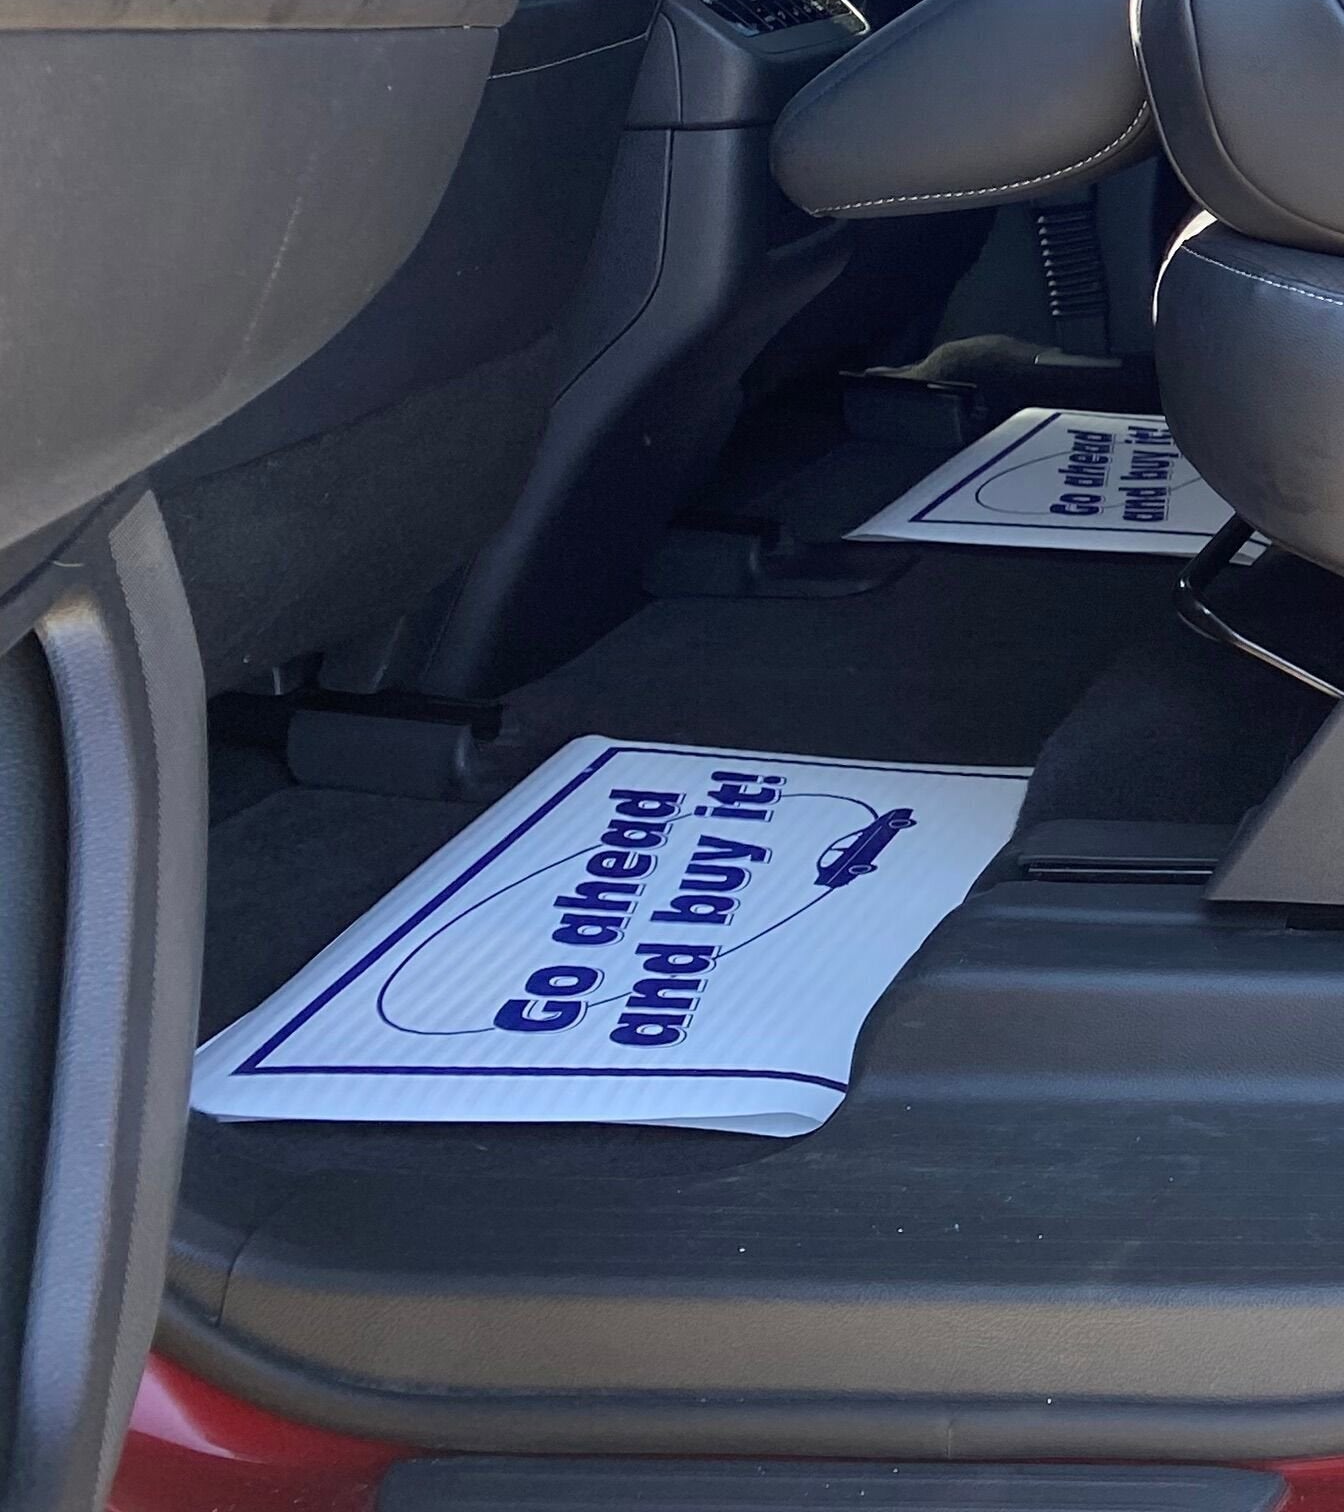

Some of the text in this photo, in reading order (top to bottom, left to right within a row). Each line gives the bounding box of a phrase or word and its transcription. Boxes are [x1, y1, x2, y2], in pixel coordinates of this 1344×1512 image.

[1049, 428, 1117, 516] Go ahead
[1118, 487, 1172, 522] and
[1120, 450, 1183, 480] buy
[493, 788, 686, 1034] Go ahead
[609, 770, 787, 1048] and buy it!
